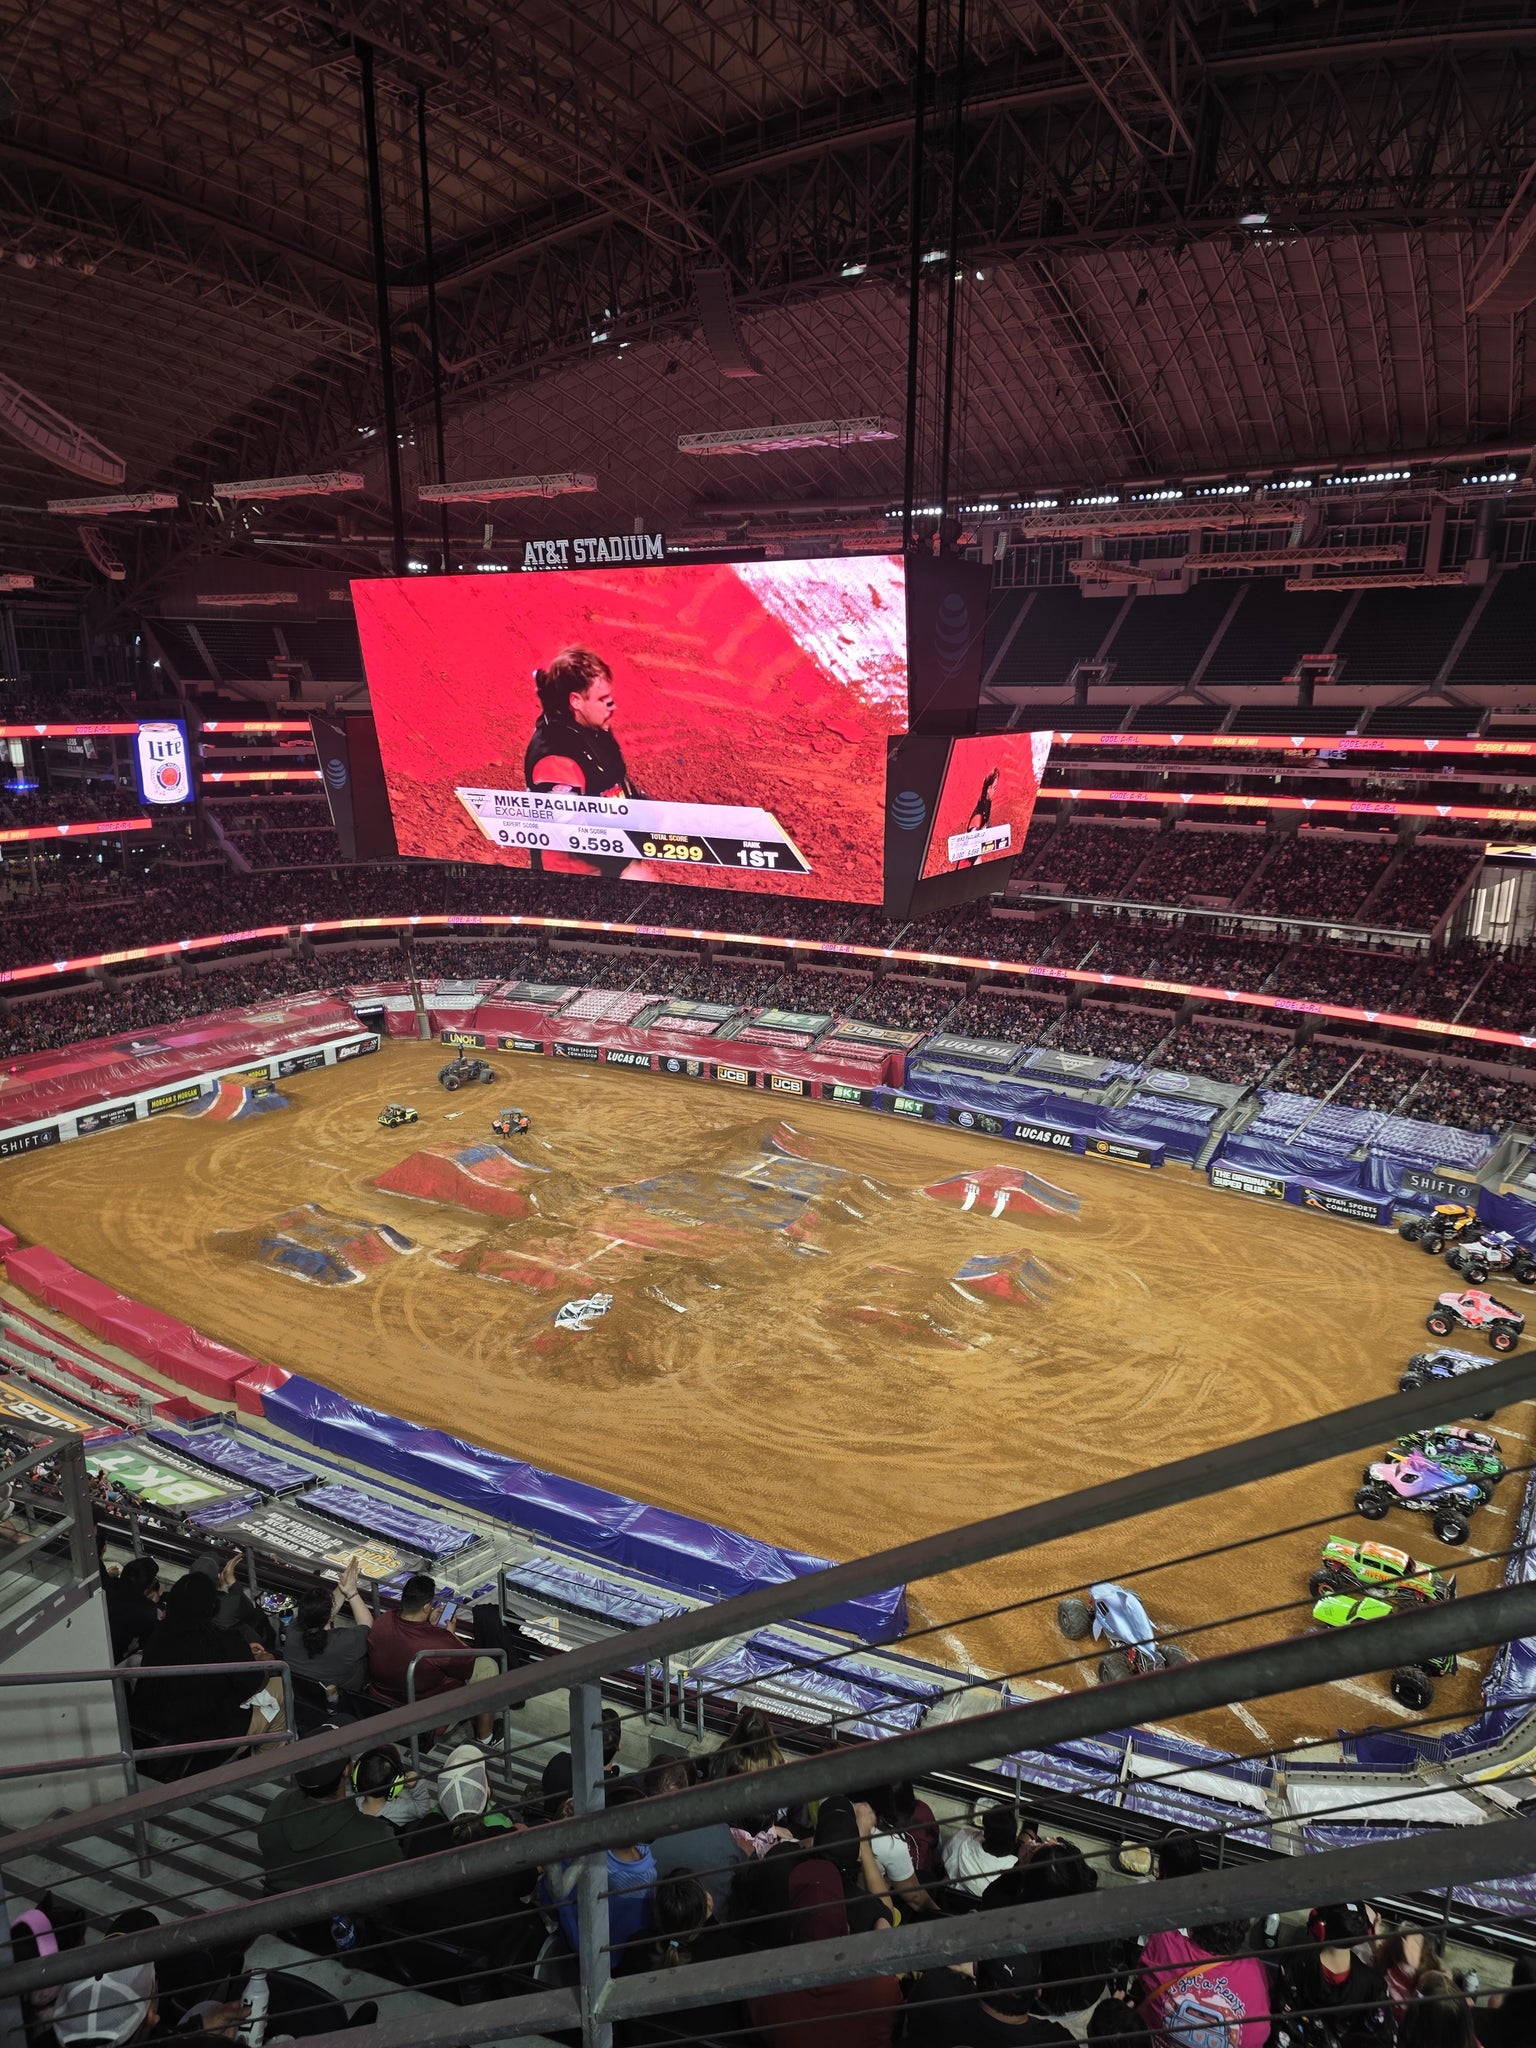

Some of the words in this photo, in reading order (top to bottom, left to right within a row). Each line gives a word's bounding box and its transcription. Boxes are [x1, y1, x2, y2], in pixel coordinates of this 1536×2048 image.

[524, 539, 569, 565] AT&T
[573, 534, 664, 563] STADIUM
[1213, 738, 1238, 746] SCORE
[1238, 738, 1259, 746] NOW!
[1339, 740, 1361, 748] CODE:
[1362, 741, 1385, 749] A-R-L
[1475, 743, 1504, 752] SCORE
[1505, 744, 1532, 753] NOW!
[147, 740, 181, 762] Lite
[494, 795, 530, 808] MIKE
[535, 798, 629, 816] PAGLIARULO
[1223, 796, 1248, 805] SCORE
[1351, 803, 1373, 811] CODE:
[1374, 804, 1397, 812] A-R-L
[495, 807, 554, 820] EXCALIBER
[1488, 811, 1517, 819] SCORE
[522, 822, 539, 830] SCORE
[589, 828, 607, 836] SCORE
[498, 830, 550, 847] 9.000
[569, 836, 624, 854] 9.598
[650, 833, 668, 841] TOTAL
[668, 835, 688, 843] SCORE
[743, 841, 761, 849] RANK
[642, 842, 703, 862] 9.299
[737, 849, 779, 868] 1ST
[1275, 999, 1299, 1009] CODE:
[1416, 1020, 1450, 1033] SCORE
[1451, 1026, 1477, 1037] NOW!
[450, 1033, 476, 1045] UNOH
[567, 1051, 597, 1059] COMMISSION
[937, 1039, 990, 1054] LUCAS
[985, 1046, 1011, 1058] OIL
[607, 1051, 635, 1065] LUCAS
[635, 1056, 650, 1067] OIL
[720, 1069, 746, 1082] JCB
[774, 1079, 800, 1092] JCB
[833, 1085, 862, 1099] BKT
[152, 1096, 172, 1108] MORGAN
[177, 1088, 197, 1100] MORGAN
[894, 1098, 924, 1112] BKT
[1, 1135, 39, 1154] SHIFT
[1015, 1126, 1051, 1143] LUCAS
[1052, 1133, 1072, 1147] OIL
[1213, 1177, 1242, 1190] SUPER
[1243, 1182, 1266, 1195] GLUE
[1215, 1170, 1231, 1180] THE
[1232, 1173, 1270, 1188] ORIGINAL
[1411, 1175, 1455, 1194] SHIFT
[1326, 1197, 1347, 1206] UTAH
[1349, 1202, 1377, 1213] SPORTS
[1326, 1203, 1377, 1219] COMMISSION
[8, 1402, 77, 1430] JCB
[137, 1444, 193, 1473] TOGETHER
[86, 1455, 213, 1503] BKT
[192, 1470, 244, 1491] GROWING
[264, 1518, 287, 1532] TEAM
[267, 1512, 290, 1523] JAM
[287, 1527, 333, 1549] RECOVERY
[288, 1520, 331, 1541] MONSTER
[263, 1533, 299, 1552] OFFICIAL
[328, 1538, 343, 1546] OF
[297, 1547, 314, 1558] THE
[325, 1551, 390, 1579] DIT
[754, 1696, 792, 1712] Hospital
[834, 1706, 853, 1715] TEXT
[794, 1707, 830, 1722] esearch
[1178, 1973, 1203, 1993] got
[1202, 1980, 1212, 1989] a
[1214, 1976, 1246, 2017] heart
